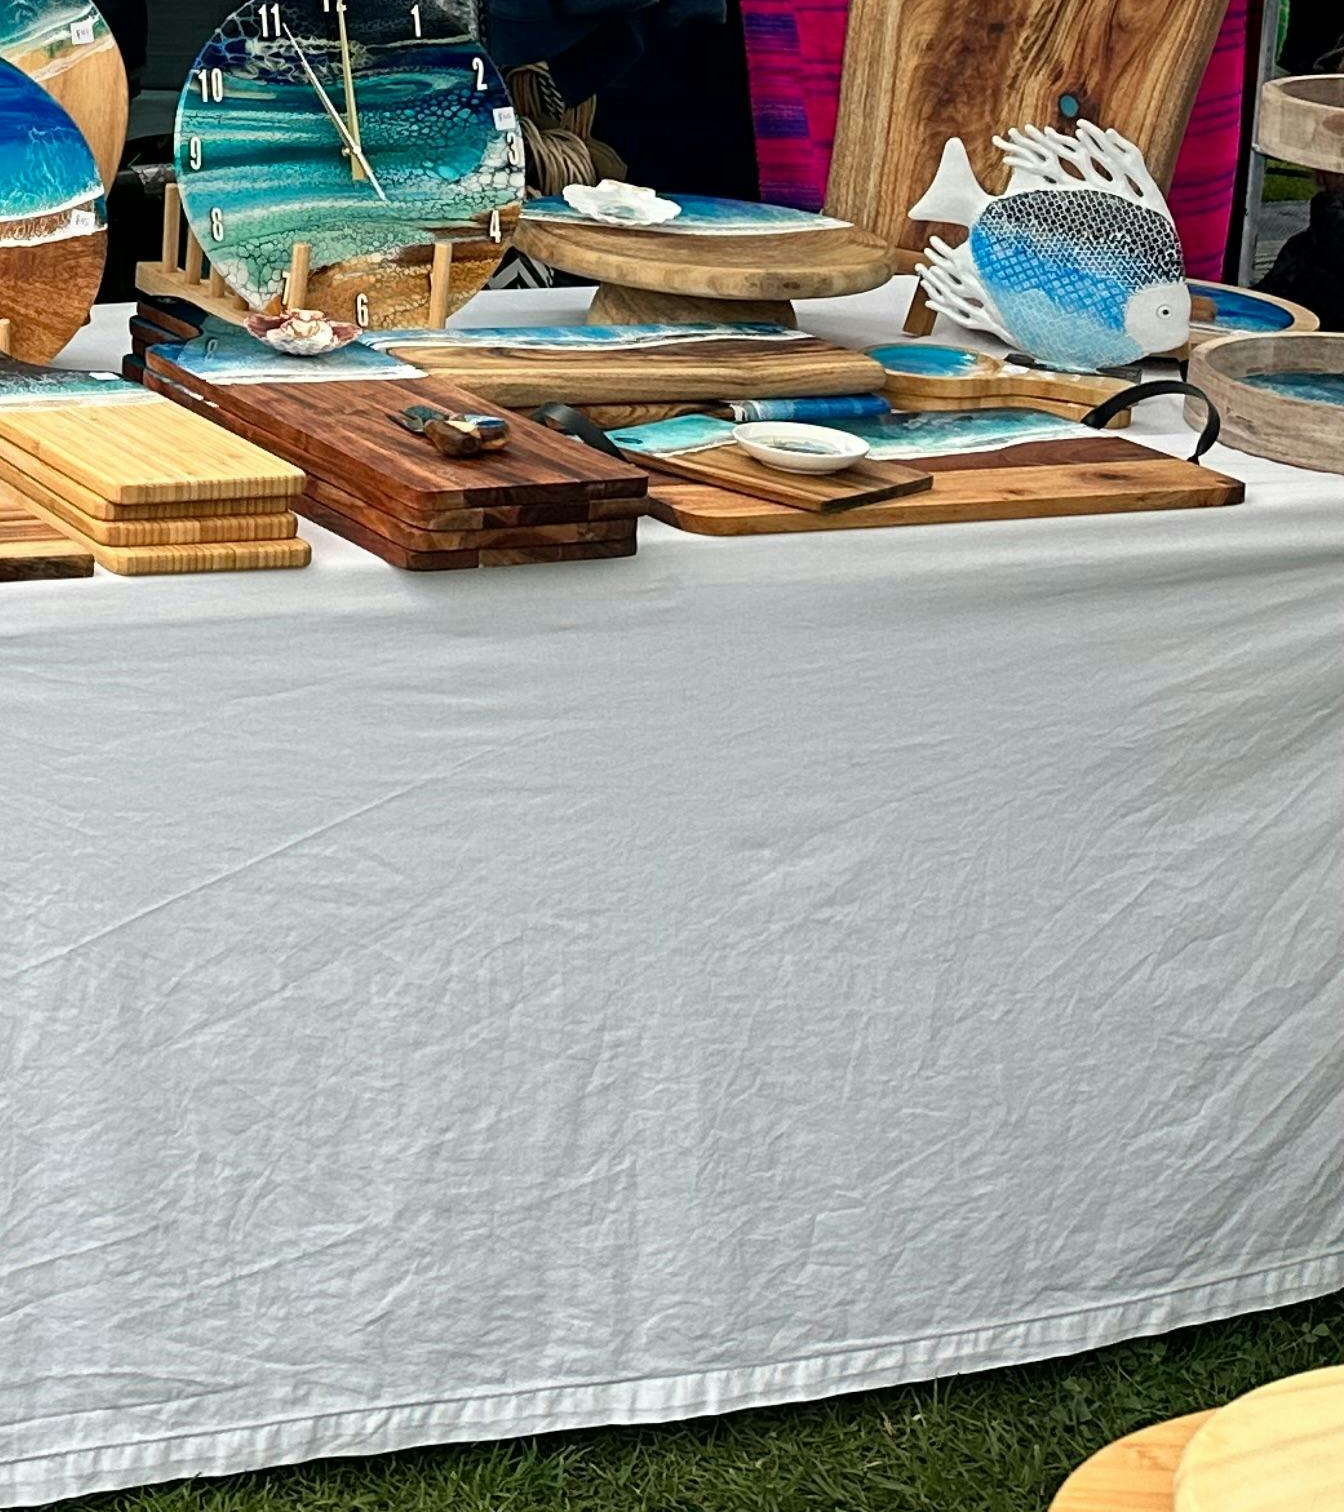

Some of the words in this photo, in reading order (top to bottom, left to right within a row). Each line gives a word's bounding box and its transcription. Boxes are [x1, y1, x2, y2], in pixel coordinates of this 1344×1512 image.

[257, 2, 282, 38] 11
[410, 4, 423, 38] 1
[197, 68, 224, 103] 10
[471, 57, 489, 91] 2
[189, 136, 203, 171] 9
[506, 130, 521, 166] 3
[211, 206, 225, 242] 8
[488, 208, 502, 244] 4
[356, 292, 370, 328] 6
